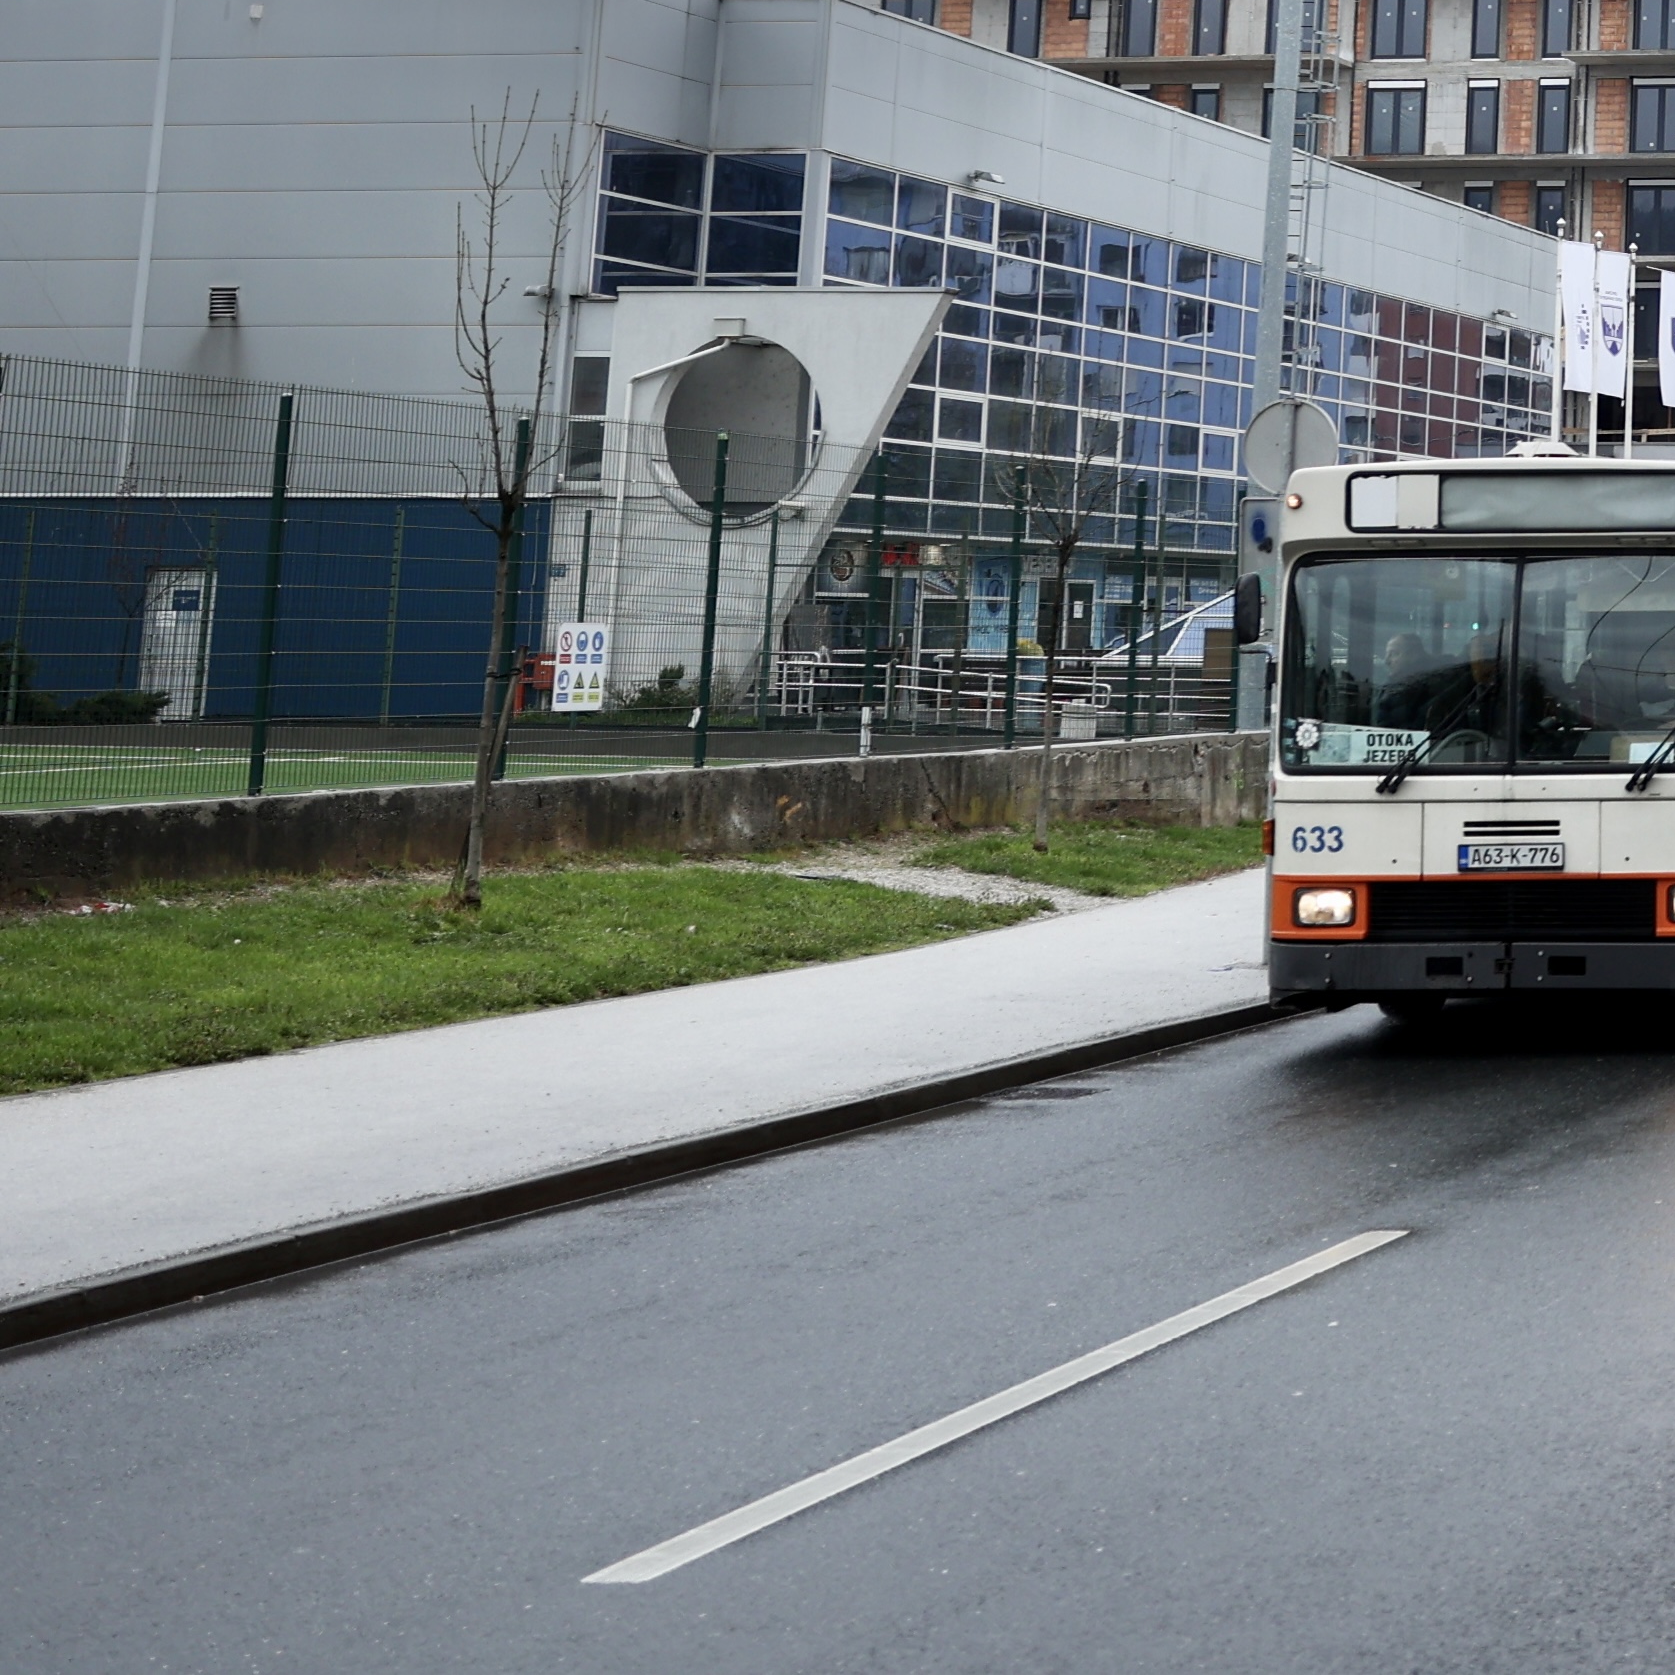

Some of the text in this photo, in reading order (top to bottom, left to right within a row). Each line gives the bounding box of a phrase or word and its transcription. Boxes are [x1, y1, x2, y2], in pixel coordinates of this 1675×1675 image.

[1366, 732, 1415, 747] OTOKA
[1291, 825, 1345, 853] 633
[1471, 846, 1561, 866] A63-K-776
